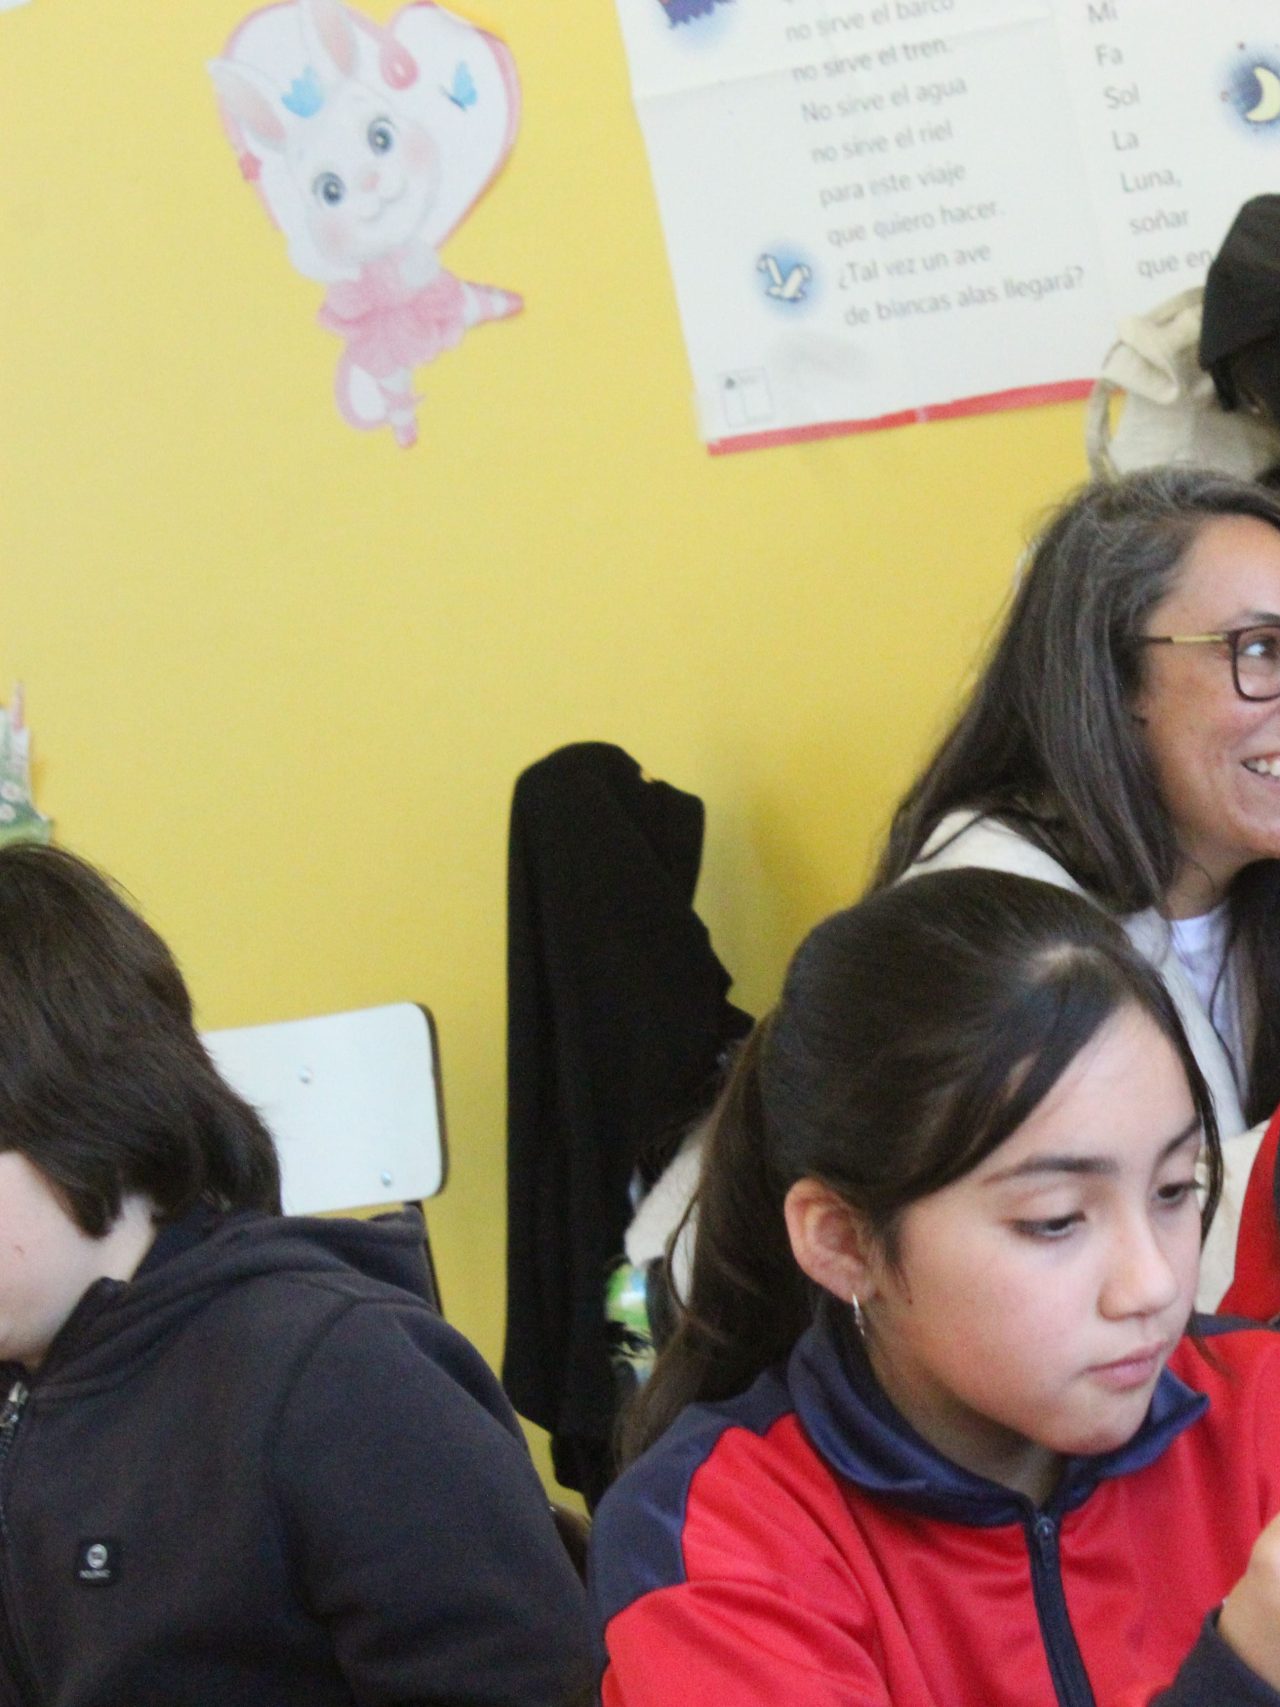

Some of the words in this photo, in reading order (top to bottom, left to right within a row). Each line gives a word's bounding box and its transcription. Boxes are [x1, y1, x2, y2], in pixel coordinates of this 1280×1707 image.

[786, 24, 811, 41] no
[817, 13, 864, 36] sirve
[871, 4, 890, 25] el
[1087, 0, 1117, 24] Mi
[791, 65, 817, 81] no
[823, 54, 872, 75] sirve
[877, 46, 898, 66] el
[1095, 44, 1123, 66] Fa
[801, 102, 831, 122] No
[837, 95, 884, 116] sirve
[890, 85, 910, 106] el
[916, 78, 967, 105] agua
[1103, 84, 1140, 110] Sol
[811, 146, 837, 162] no
[842, 137, 887, 158] sirve
[895, 128, 914, 148] el
[919, 120, 953, 142] riel
[1112, 131, 1139, 151] La
[820, 184, 864, 208] para
[870, 174, 910, 195] este
[917, 162, 966, 189] viaje
[1120, 169, 1181, 194] Luna,
[828, 225, 865, 248] que
[873, 213, 935, 238] quiero
[1129, 209, 1189, 235] soñar
[839, 261, 878, 290] ¿Tal
[886, 258, 915, 275] vez
[922, 253, 949, 271] un
[955, 245, 990, 265] ave
[1138, 254, 1180, 279] que
[844, 306, 869, 326] de
[958, 286, 999, 307] alas
[1004, 266, 1084, 299] llegará?
